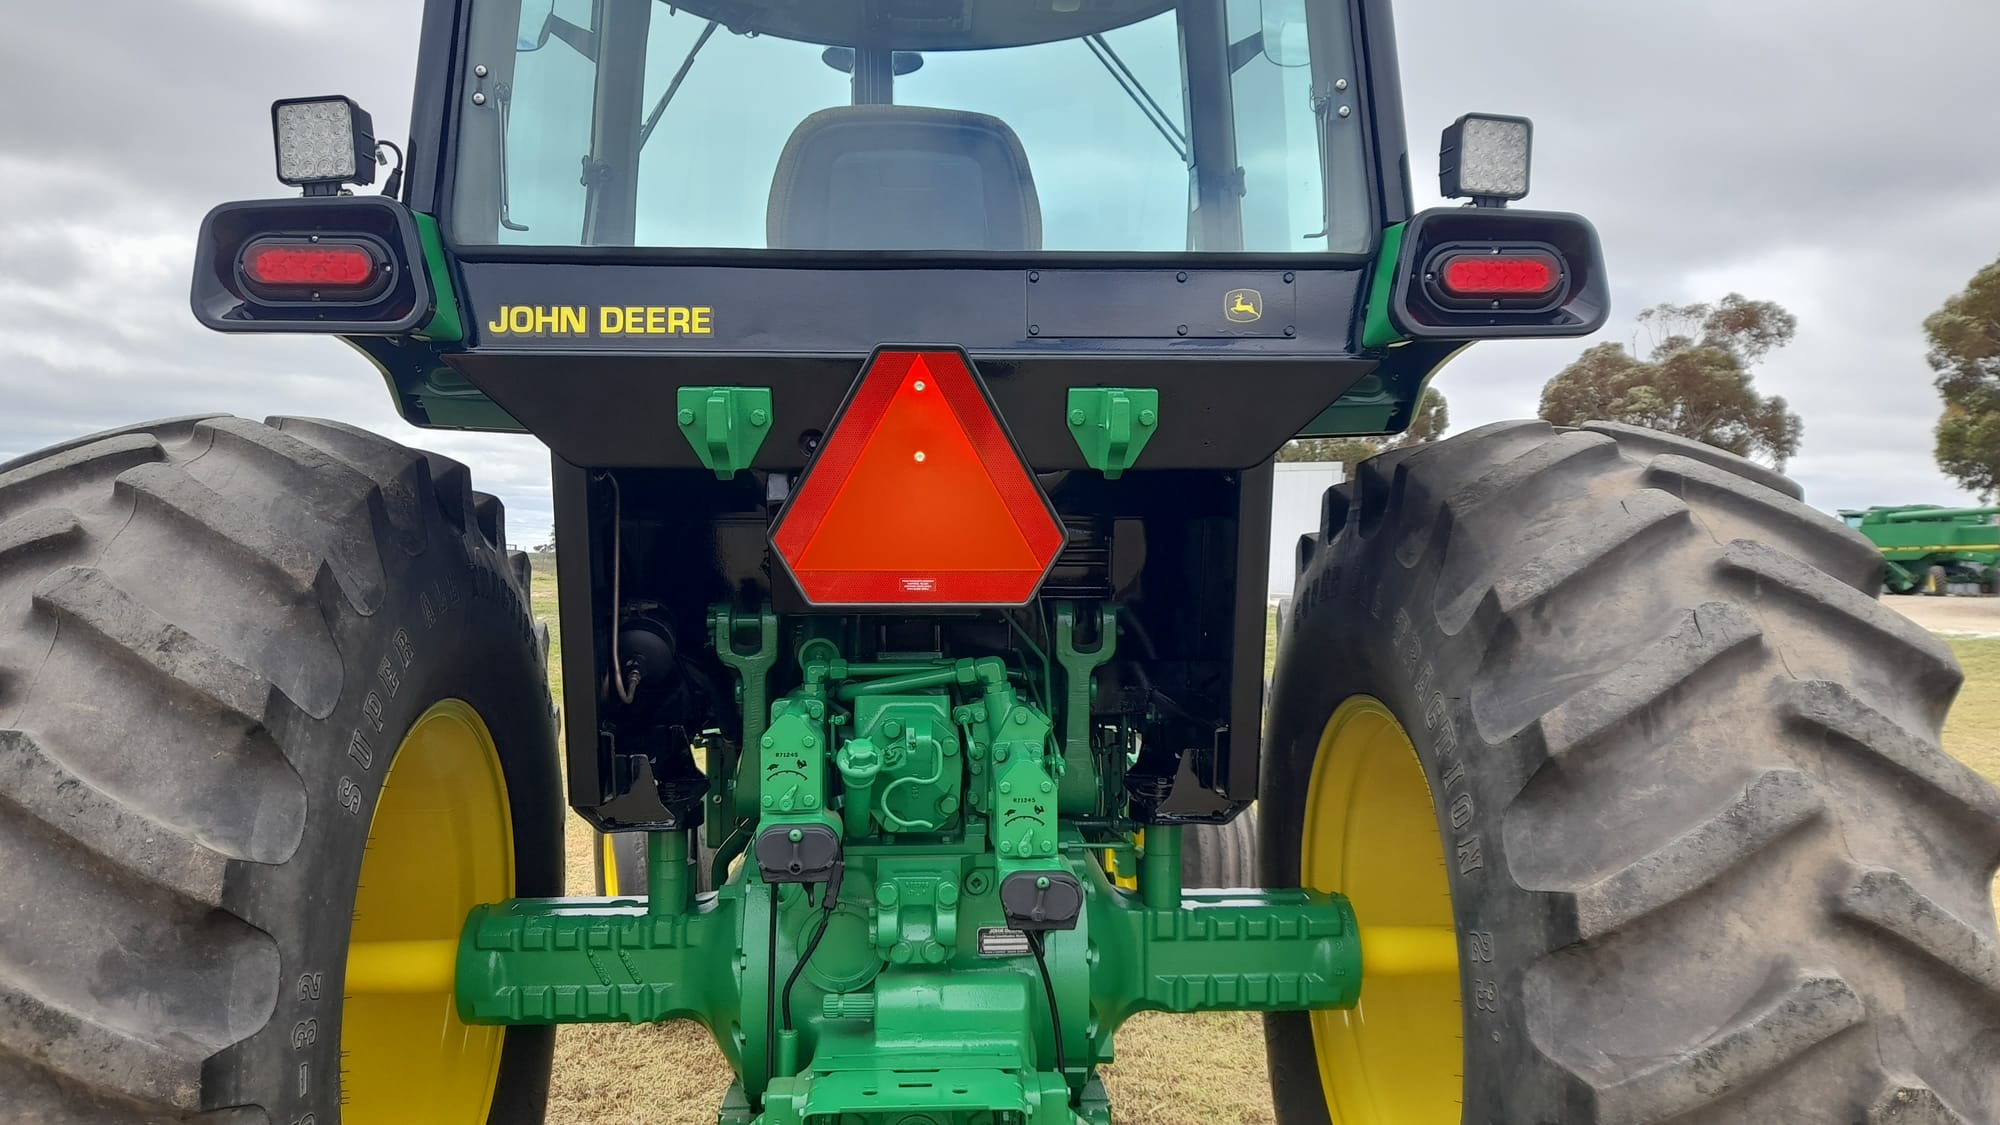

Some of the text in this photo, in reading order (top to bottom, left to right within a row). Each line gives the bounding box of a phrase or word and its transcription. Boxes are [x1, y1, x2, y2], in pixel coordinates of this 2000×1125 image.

[488, 306, 712, 335] JOHN DEERE
[337, 627, 415, 816] SUPER
[1393, 606, 1485, 878] TRACTION
